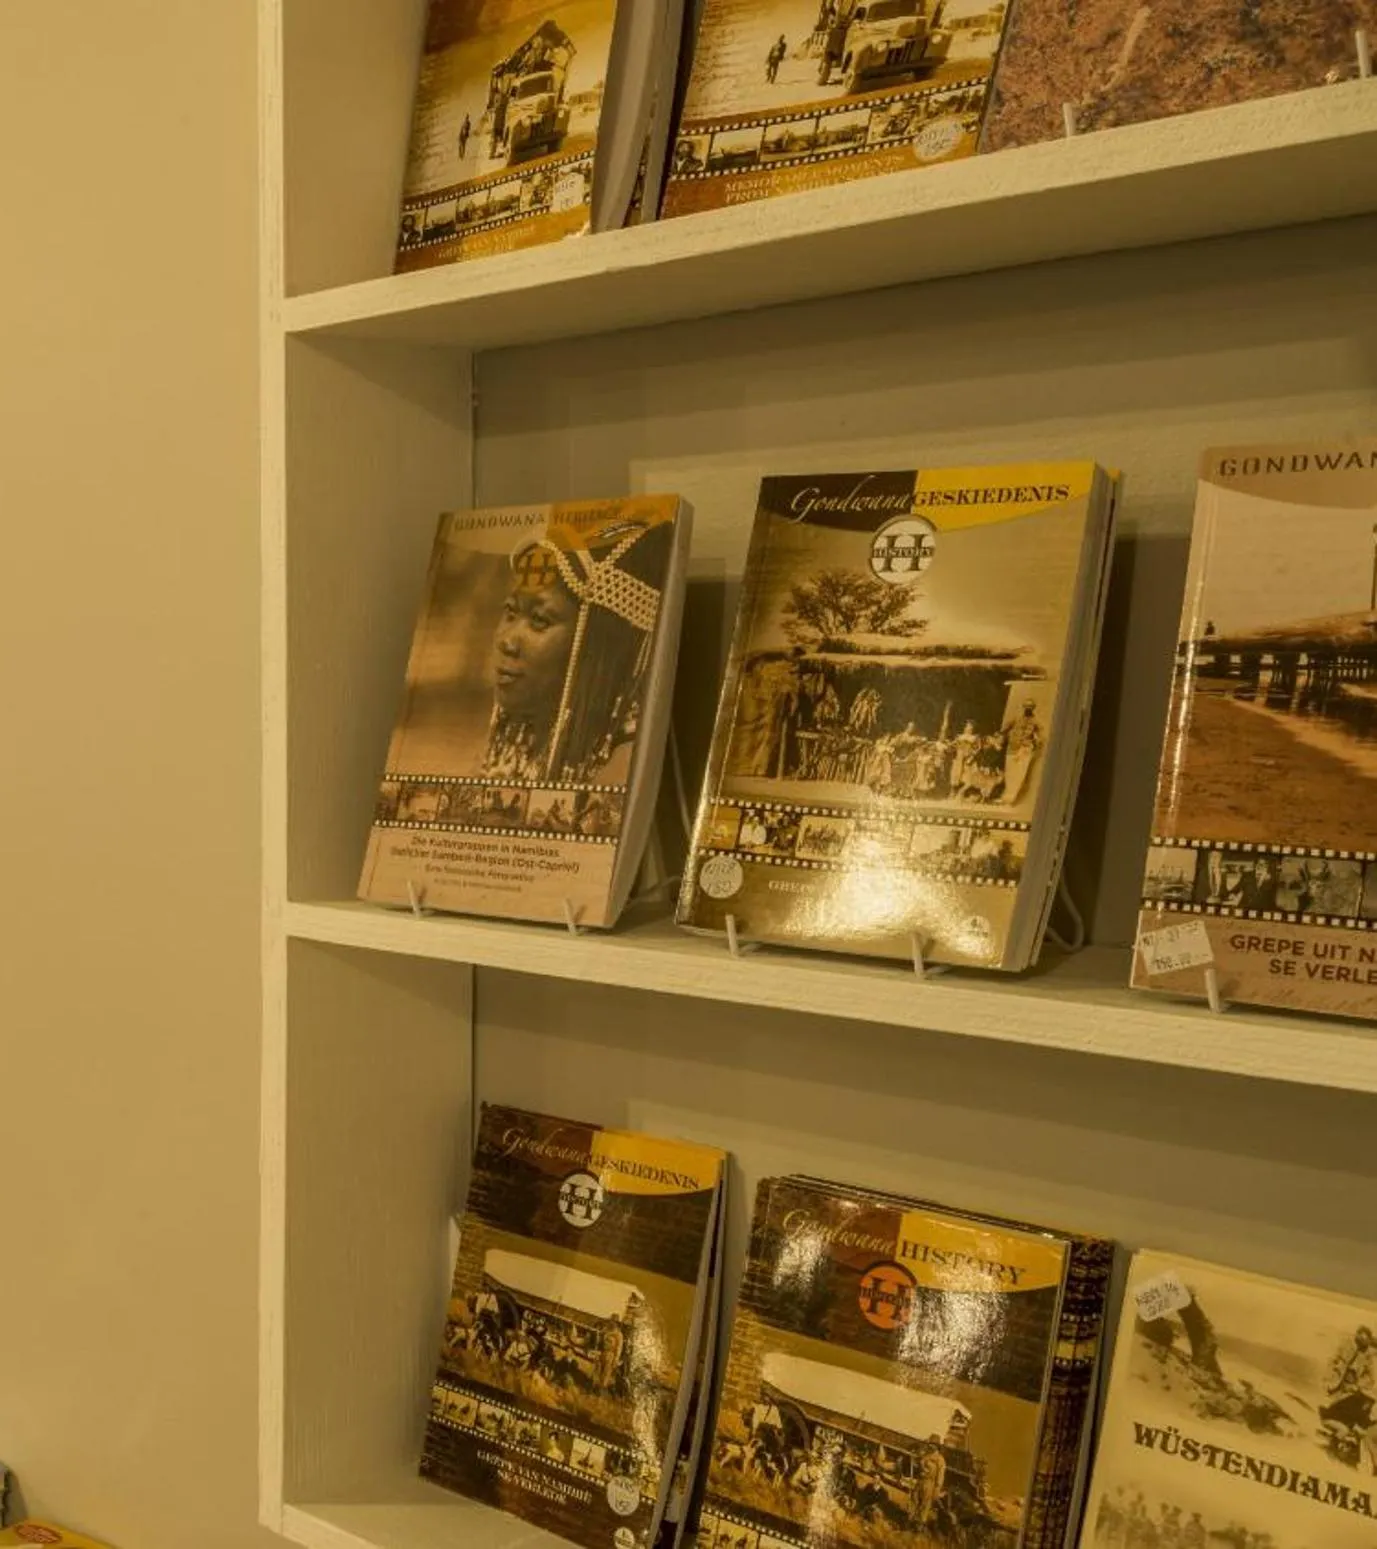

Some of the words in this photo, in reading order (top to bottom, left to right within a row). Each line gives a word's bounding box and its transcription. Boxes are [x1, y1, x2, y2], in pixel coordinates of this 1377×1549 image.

[789, 474, 913, 525] Gondwana
[913, 484, 1071, 506] GESKIEDENIS
[1229, 934, 1306, 956] GREPE
[1313, 941, 1352, 961] UIT
[1269, 958, 1298, 977] SE
[901, 1239, 1026, 1285] HISTORY
[1132, 1421, 1377, 1520] WÜSTENDIAMA
